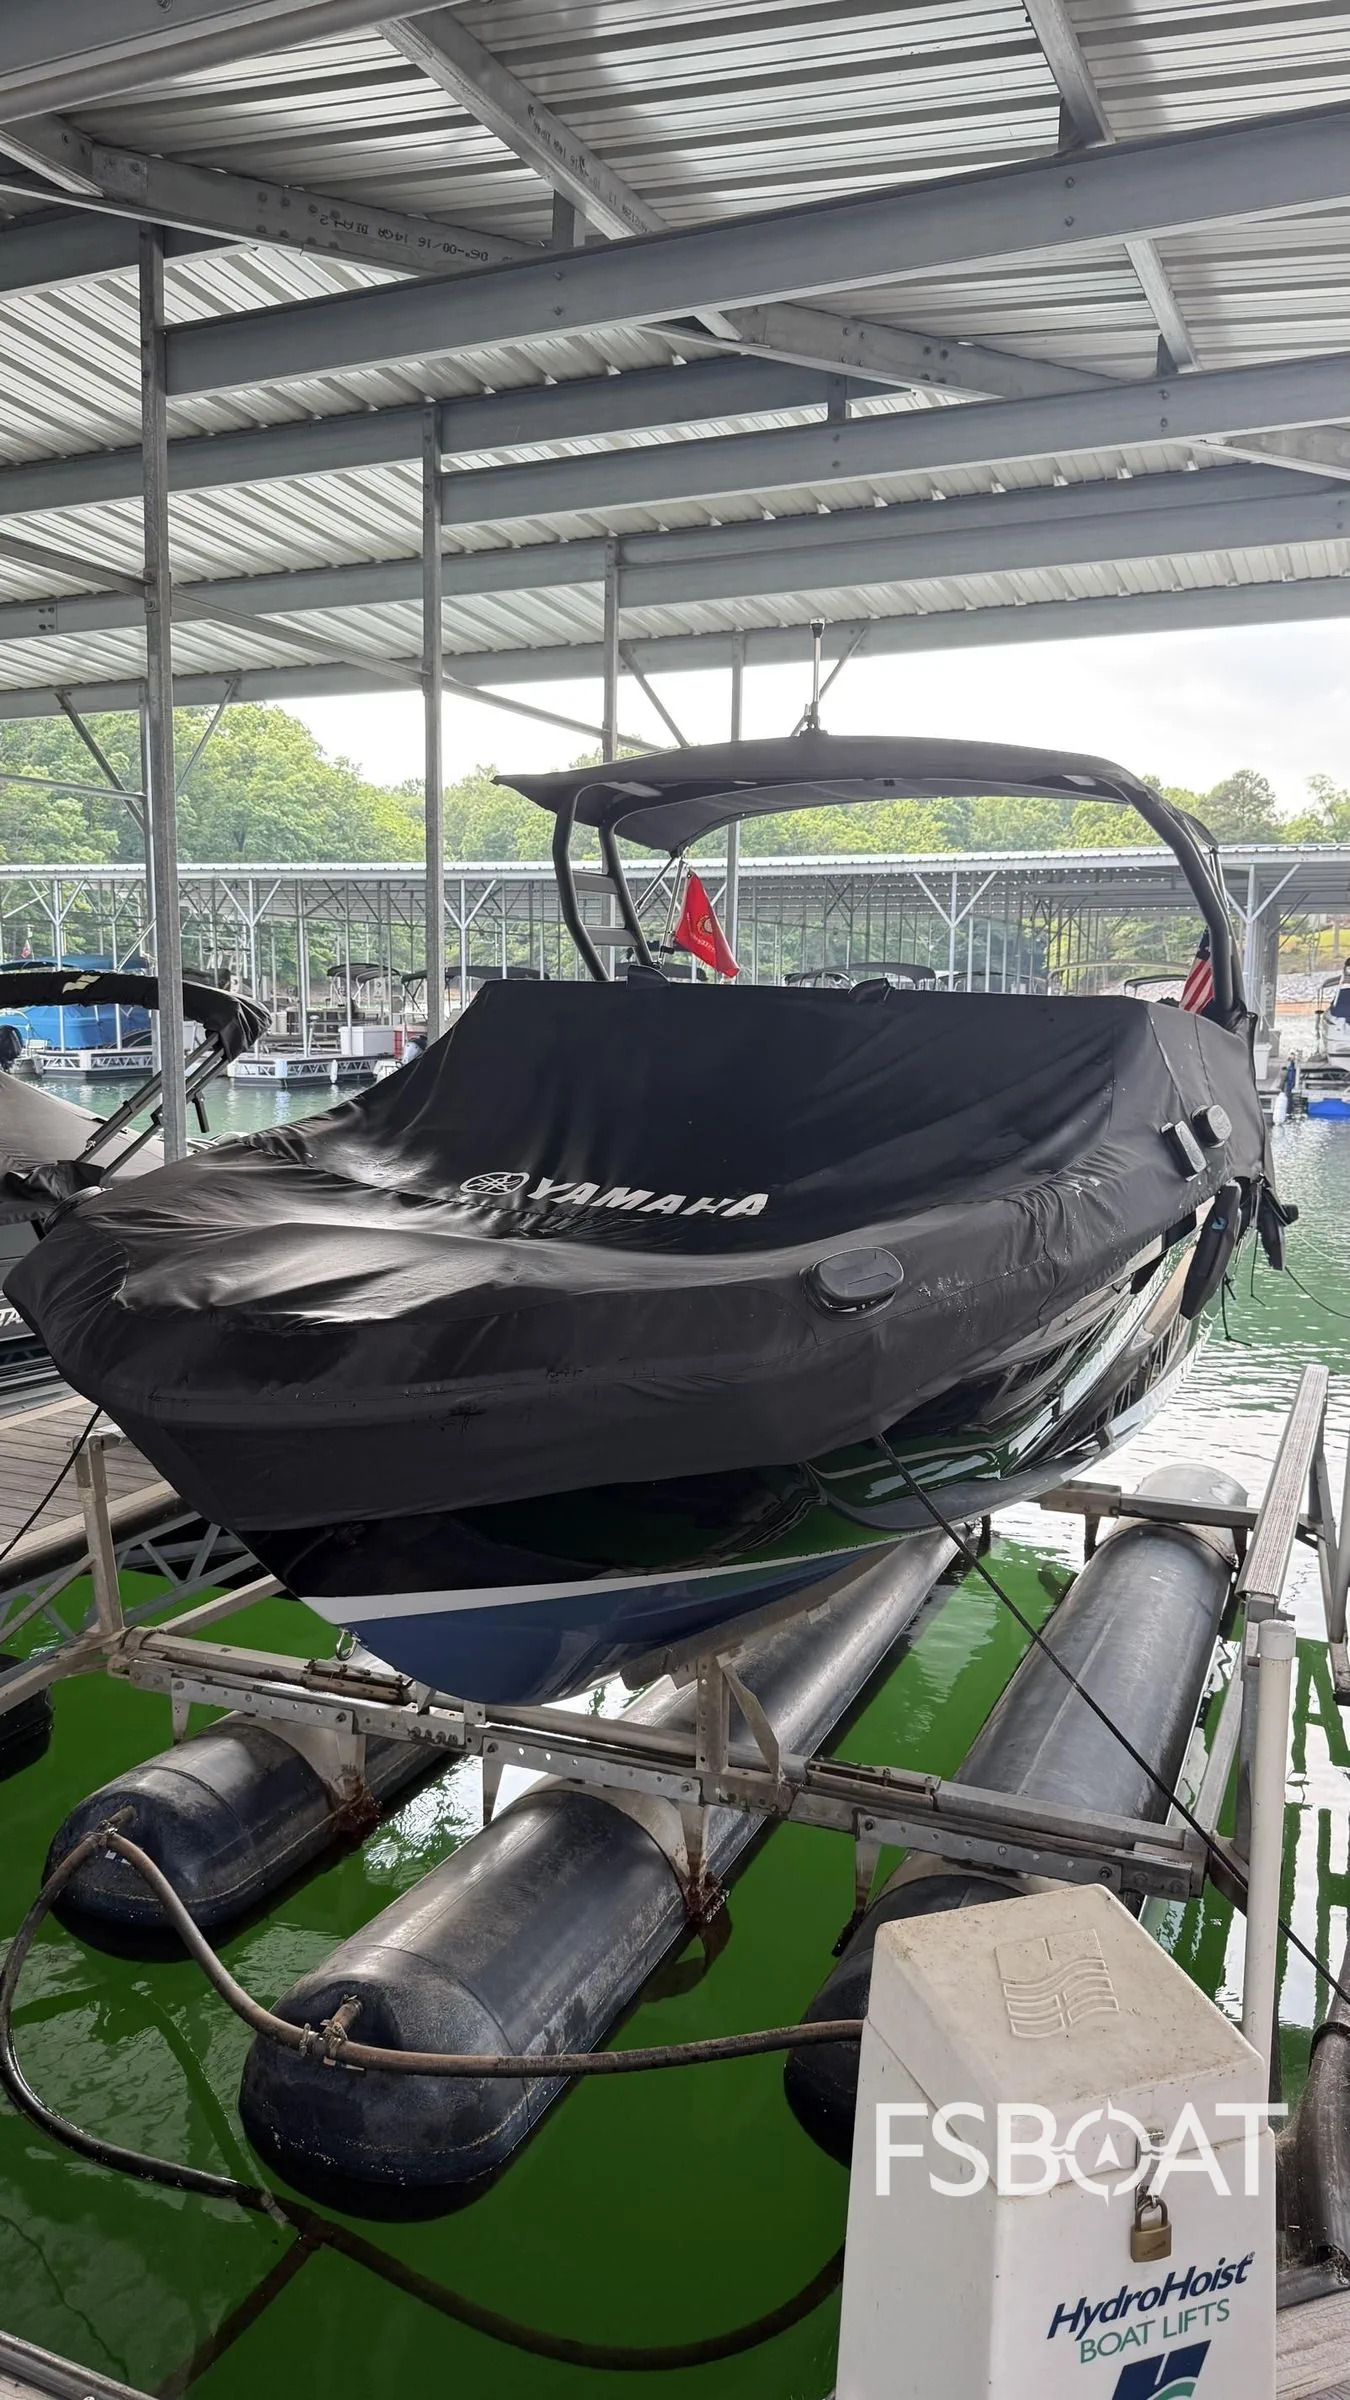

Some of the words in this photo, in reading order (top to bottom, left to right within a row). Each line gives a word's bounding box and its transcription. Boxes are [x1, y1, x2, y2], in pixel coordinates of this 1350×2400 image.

[526, 1176, 769, 1218] YAMAHA
[1080, 2320, 1155, 2364] BOAT
[1163, 2298, 1230, 2339] LIFTS
